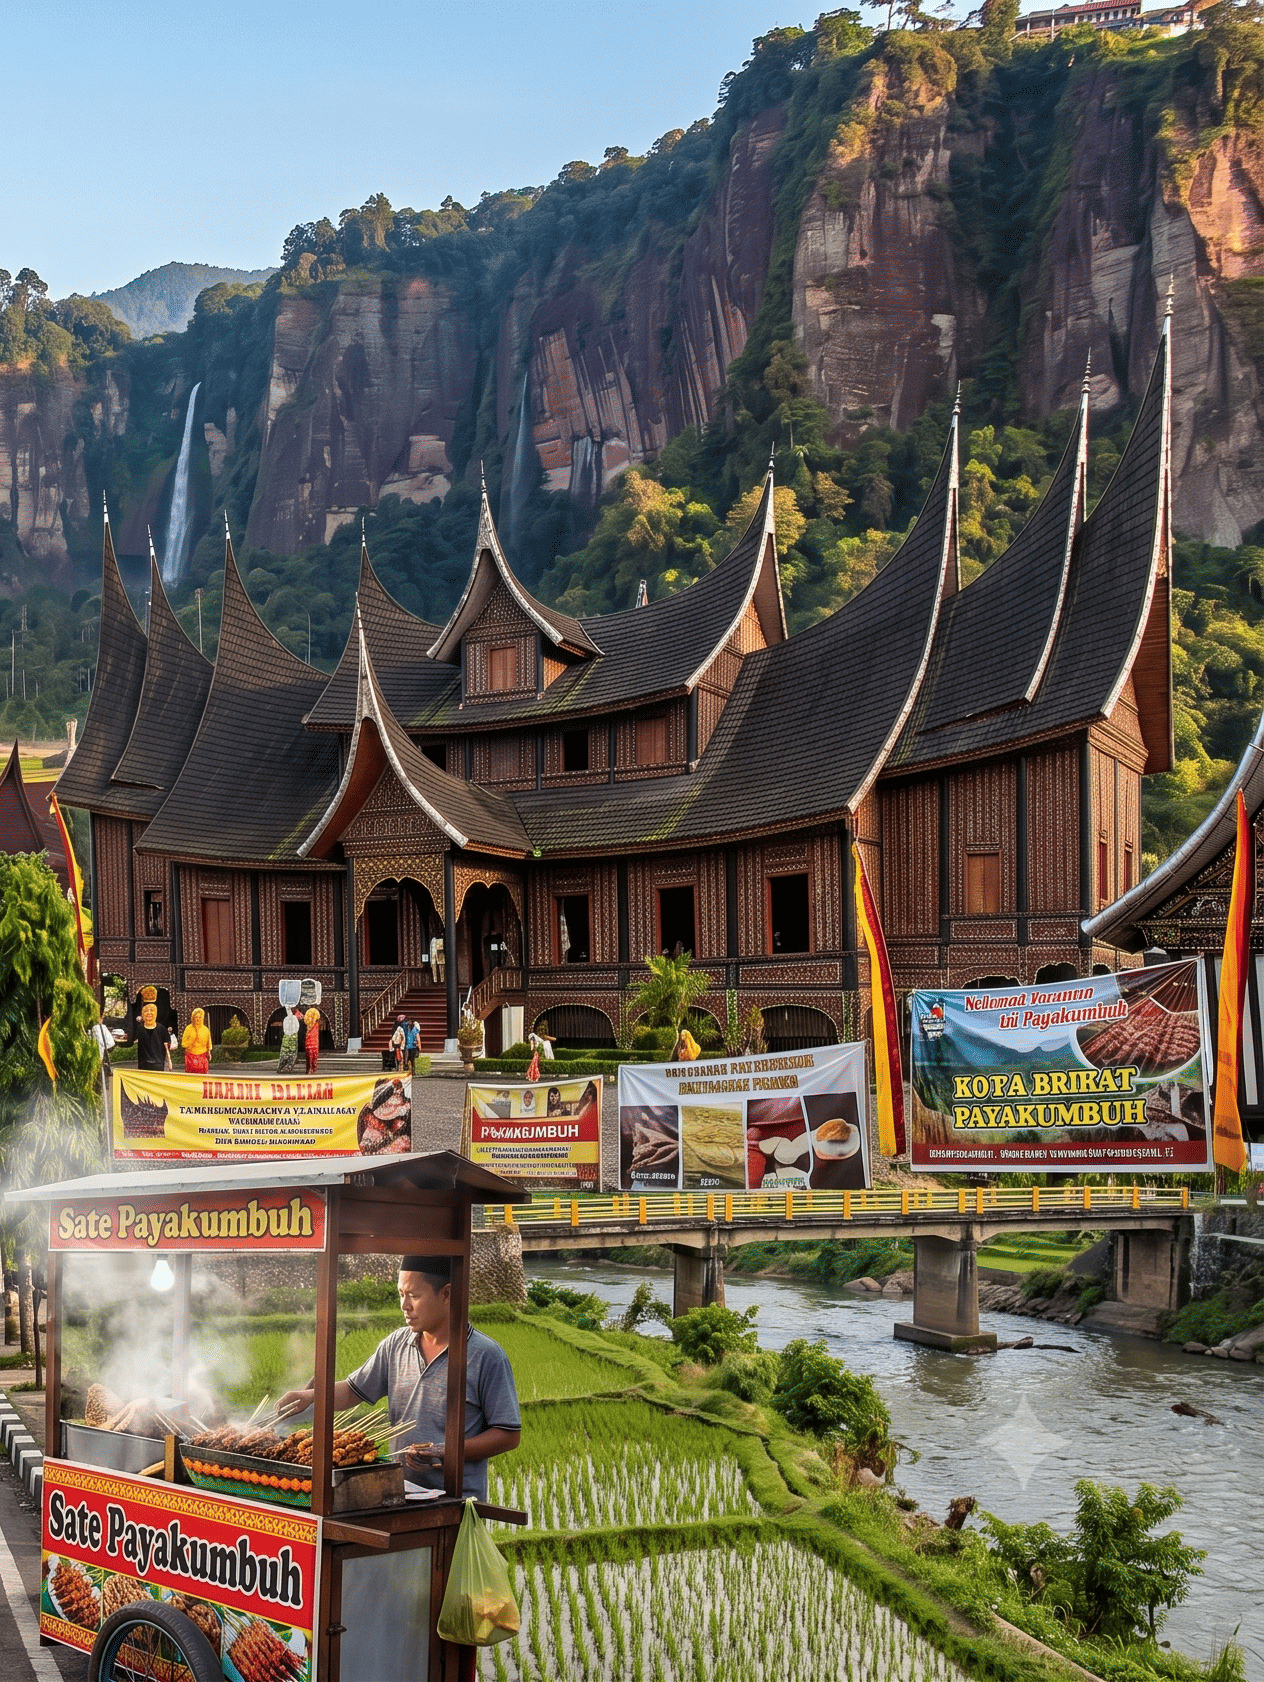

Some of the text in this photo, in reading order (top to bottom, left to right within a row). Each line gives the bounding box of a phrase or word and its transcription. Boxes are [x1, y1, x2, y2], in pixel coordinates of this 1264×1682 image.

[953, 1099, 1148, 1129] PAYAKUMBUH
[58, 1198, 313, 1247] Sate Payakumbuh
[49, 1491, 303, 1608] Sate Payakumbuh
